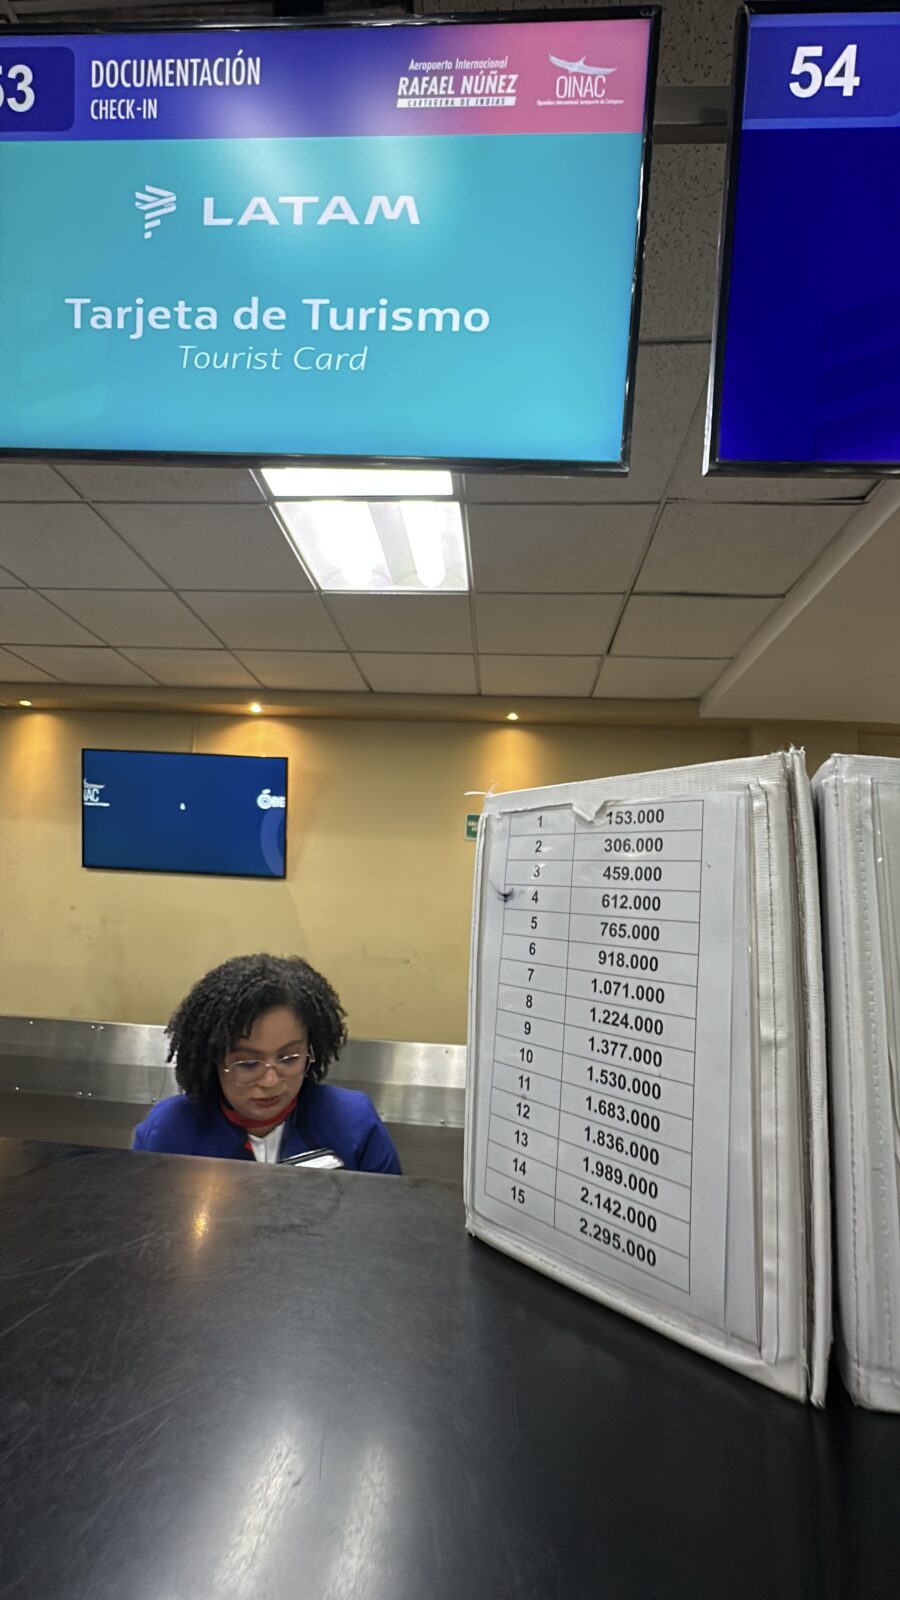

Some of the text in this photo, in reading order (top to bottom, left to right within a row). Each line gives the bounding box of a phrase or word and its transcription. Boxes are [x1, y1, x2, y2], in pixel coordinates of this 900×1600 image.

[90, 50, 261, 88] DOCUMENTACIÓN
[408, 55, 508, 72] Aeropuerto Internacional
[789, 44, 861, 98] 54
[0, 64, 35, 112] 3
[397, 70, 518, 96] RAFAEL NÚÑEZ
[555, 74, 606, 99] OINAC
[90, 98, 157, 120] CHECK-IN
[407, 97, 506, 107] CARTAGENA DE INDIAS
[203, 195, 420, 226] LATAM
[64, 297, 490, 340] Tarjeta de Turismo
[178, 346, 369, 371] Tourist Card
[536, 808, 665, 828] 1 153.000
[535, 837, 664, 854] 2 306.000
[533, 865, 663, 882] 3 459.000
[531, 890, 662, 912] 4 612.000
[530, 916, 661, 942] 5 765.000
[528, 942, 660, 972] 6 918.000
[527, 968, 665, 1004] 7 1.071.000
[525, 994, 664, 1036] 8 1.224.000
[523, 1021, 663, 1068] 9 1.377.000
[519, 1047, 662, 1100] 10 1.530.000
[517, 1074, 661, 1133] 11 1.683.000
[516, 1101, 660, 1166] 12 1.836.000
[514, 1129, 659, 1199] 13 1.989.000
[512, 1157, 658, 1234] 14 2.142.000
[510, 1185, 657, 1268] 15 2.295.000
